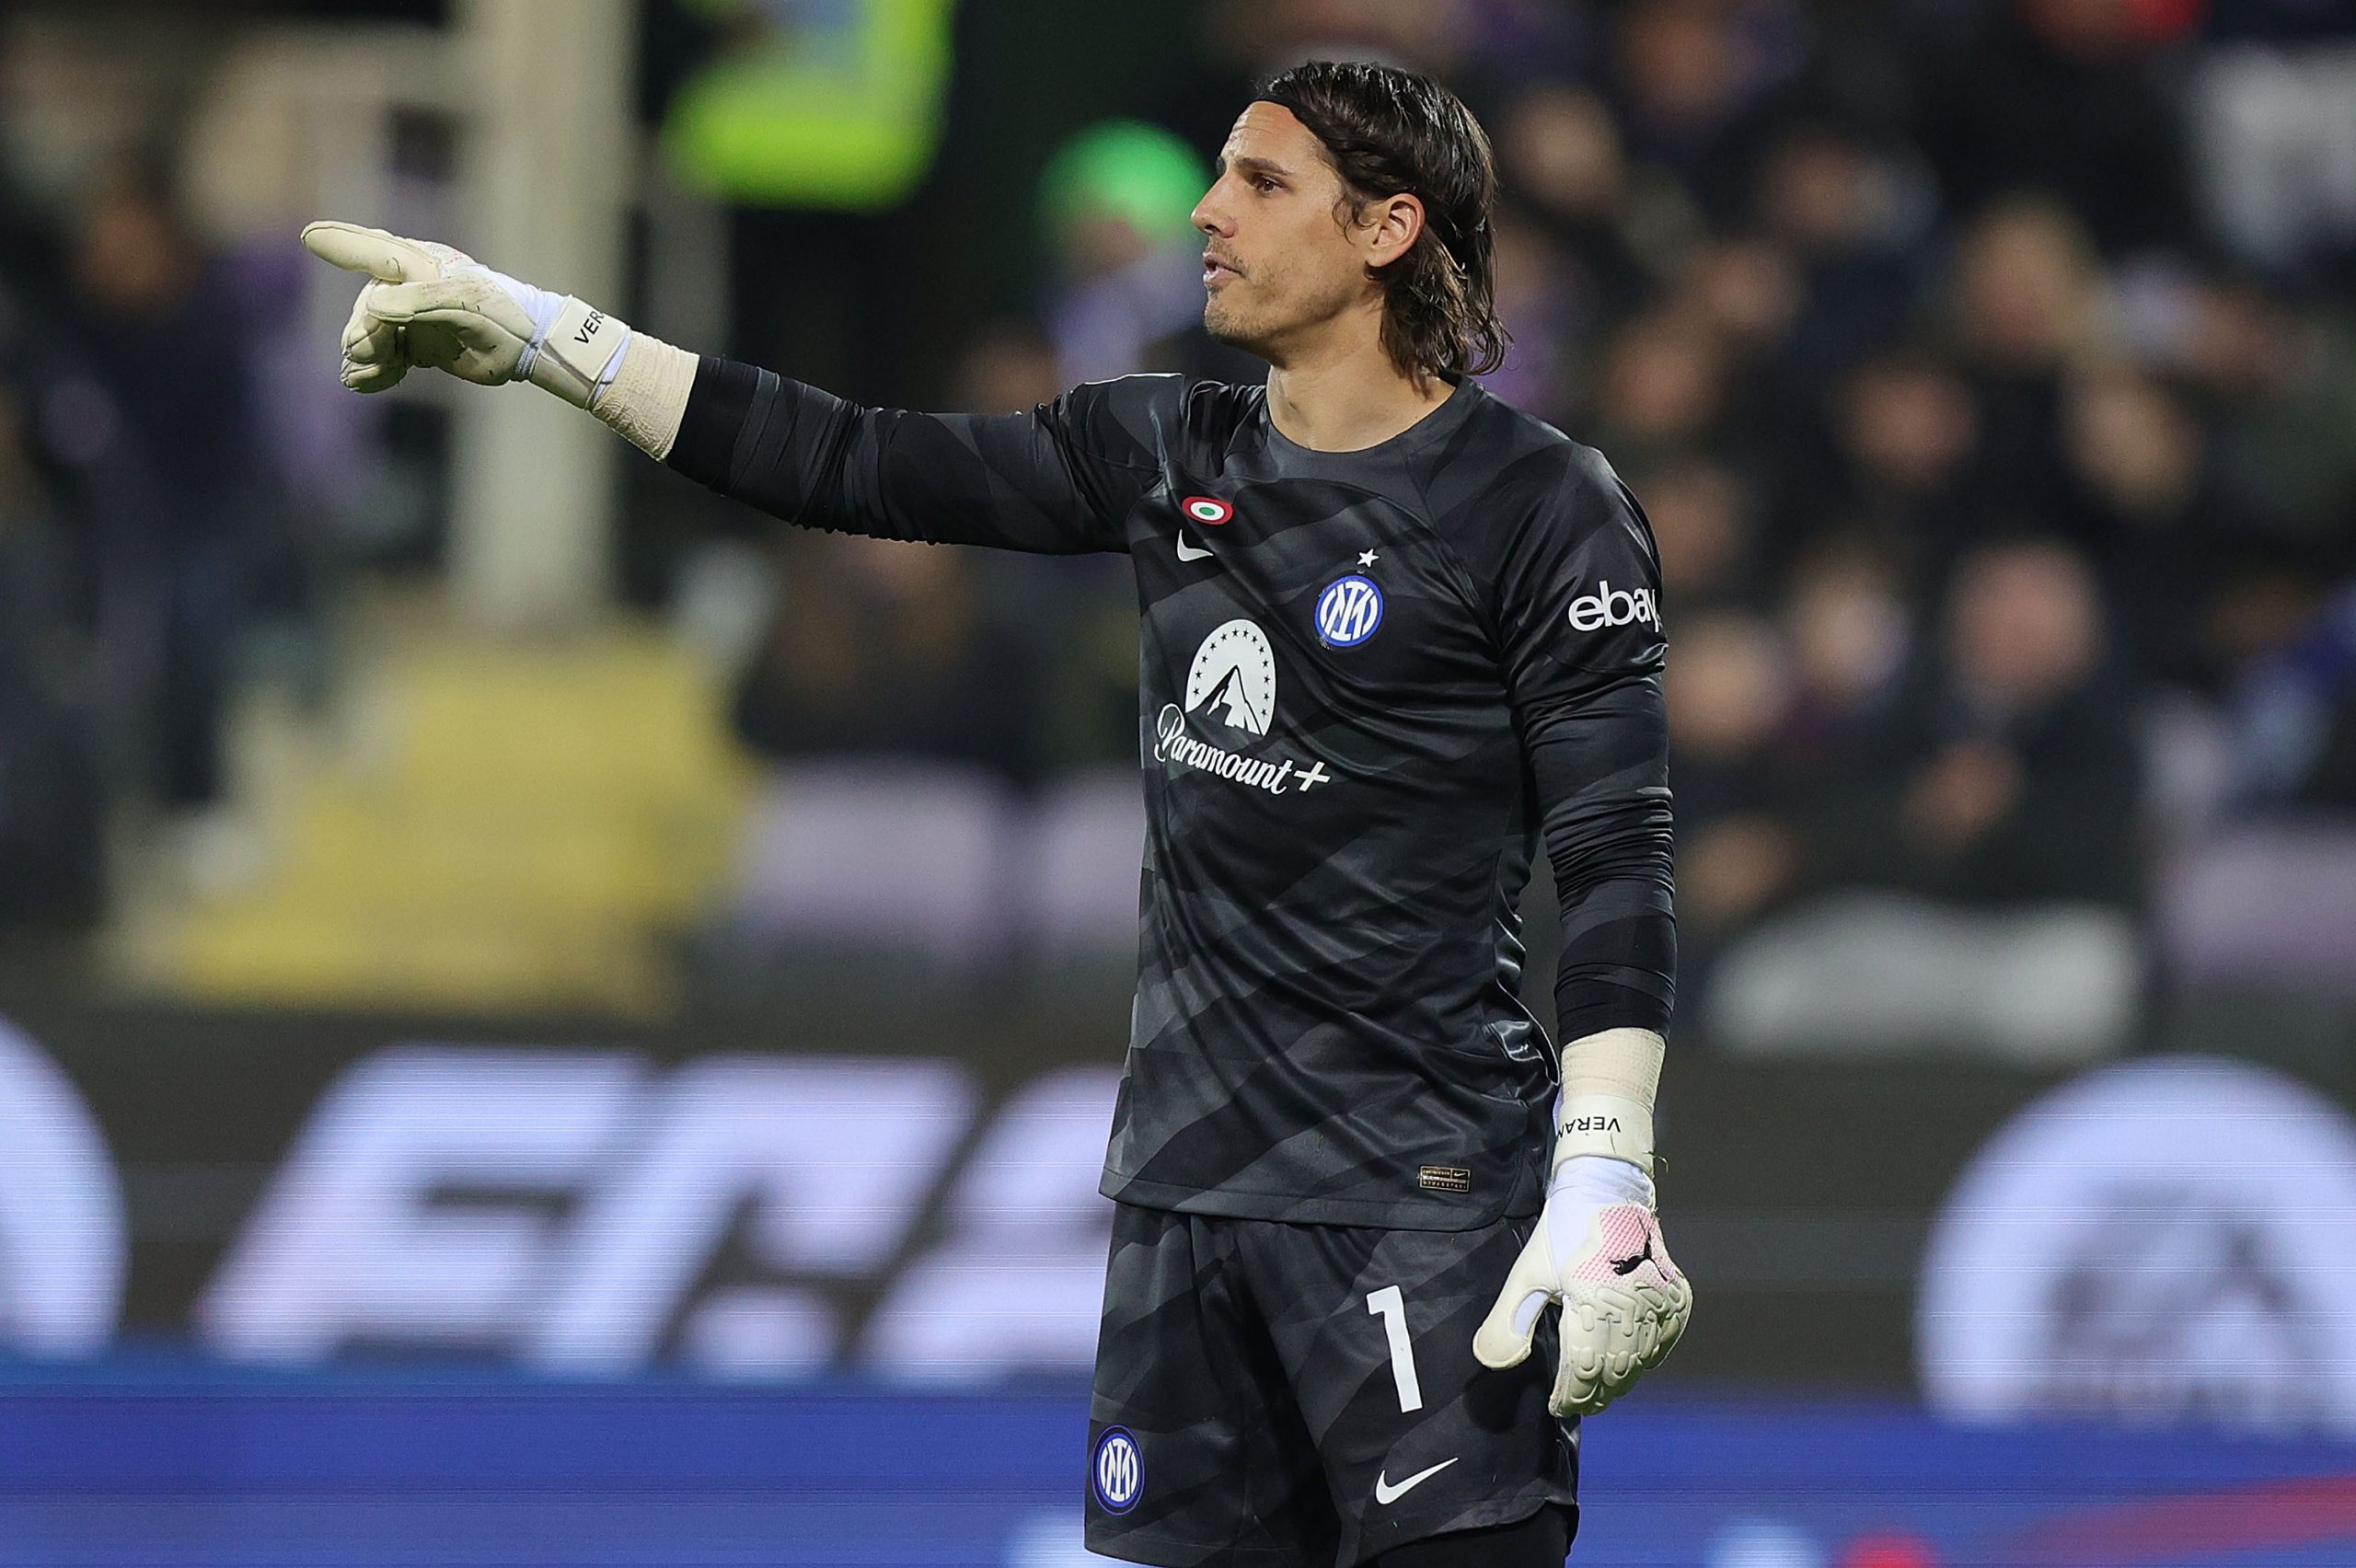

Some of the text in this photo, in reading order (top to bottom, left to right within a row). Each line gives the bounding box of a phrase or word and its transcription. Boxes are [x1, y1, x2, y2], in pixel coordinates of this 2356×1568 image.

[573, 310, 605, 344] VER
[1568, 580, 1660, 632] ebay
[1366, 1285, 1423, 1413] 1
